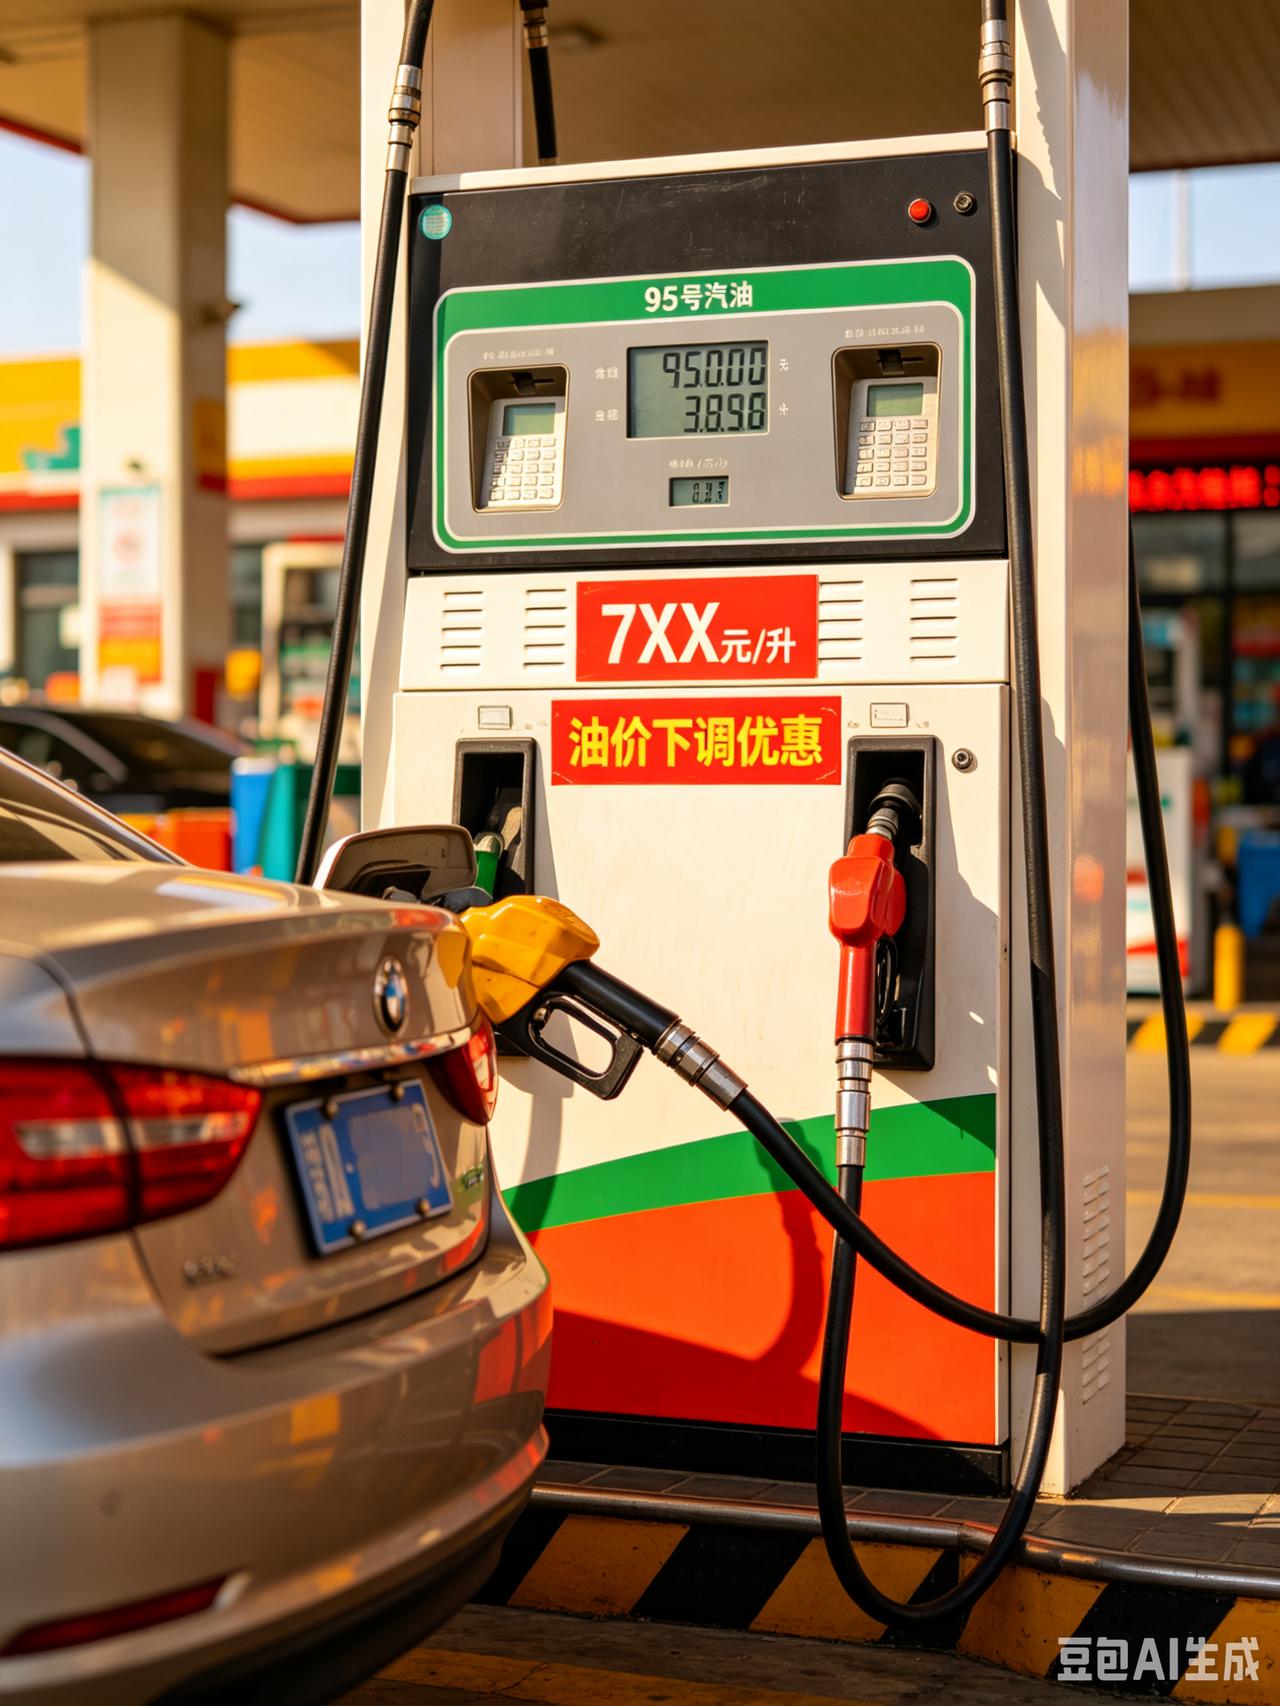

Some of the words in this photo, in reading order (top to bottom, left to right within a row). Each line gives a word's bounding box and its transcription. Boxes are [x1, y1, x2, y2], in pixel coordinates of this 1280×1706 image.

[644, 280, 753, 312] 95号汽油
[601, 602, 797, 664] 7XX元/升
[568, 714, 823, 768] 油价下调优惠
